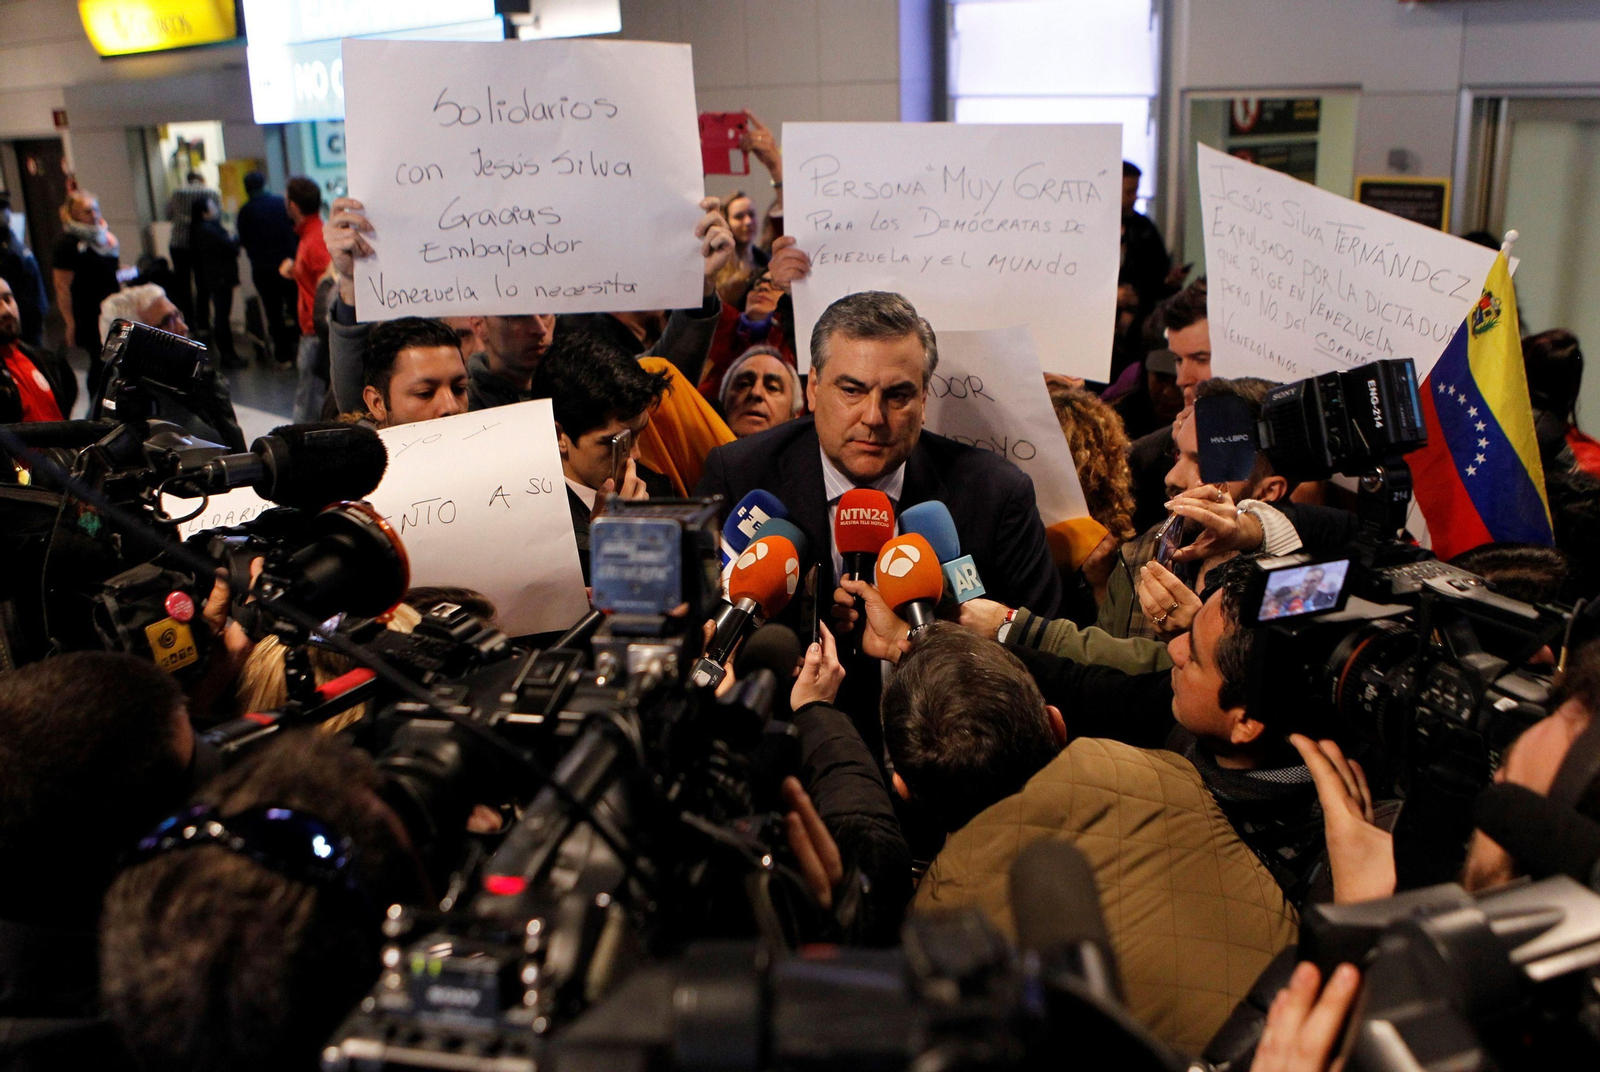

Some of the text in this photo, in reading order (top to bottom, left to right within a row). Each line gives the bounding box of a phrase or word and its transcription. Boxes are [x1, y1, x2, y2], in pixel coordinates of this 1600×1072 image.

[433, 86, 618, 127] Solidarios
[396, 147, 632, 186] con Jesús Silva
[800, 154, 926, 201] PERSONA
[438, 196, 562, 231] Gracias
[806, 206, 1086, 238] PARA LOS DEMÓCRATAS DE
[419, 234, 583, 267] Embajador
[940, 250, 971, 268] EL
[368, 272, 638, 309] Venezuela lo necesita
[1289, 284, 1305, 302] EN
[1302, 259, 1333, 294] POR
[1338, 267, 1358, 303] LA
[1271, 387, 1297, 401] SONY
[488, 485, 512, 508] A
[525, 477, 553, 494] SU
[840, 508, 889, 522] NTN24
[955, 561, 983, 595] AR
